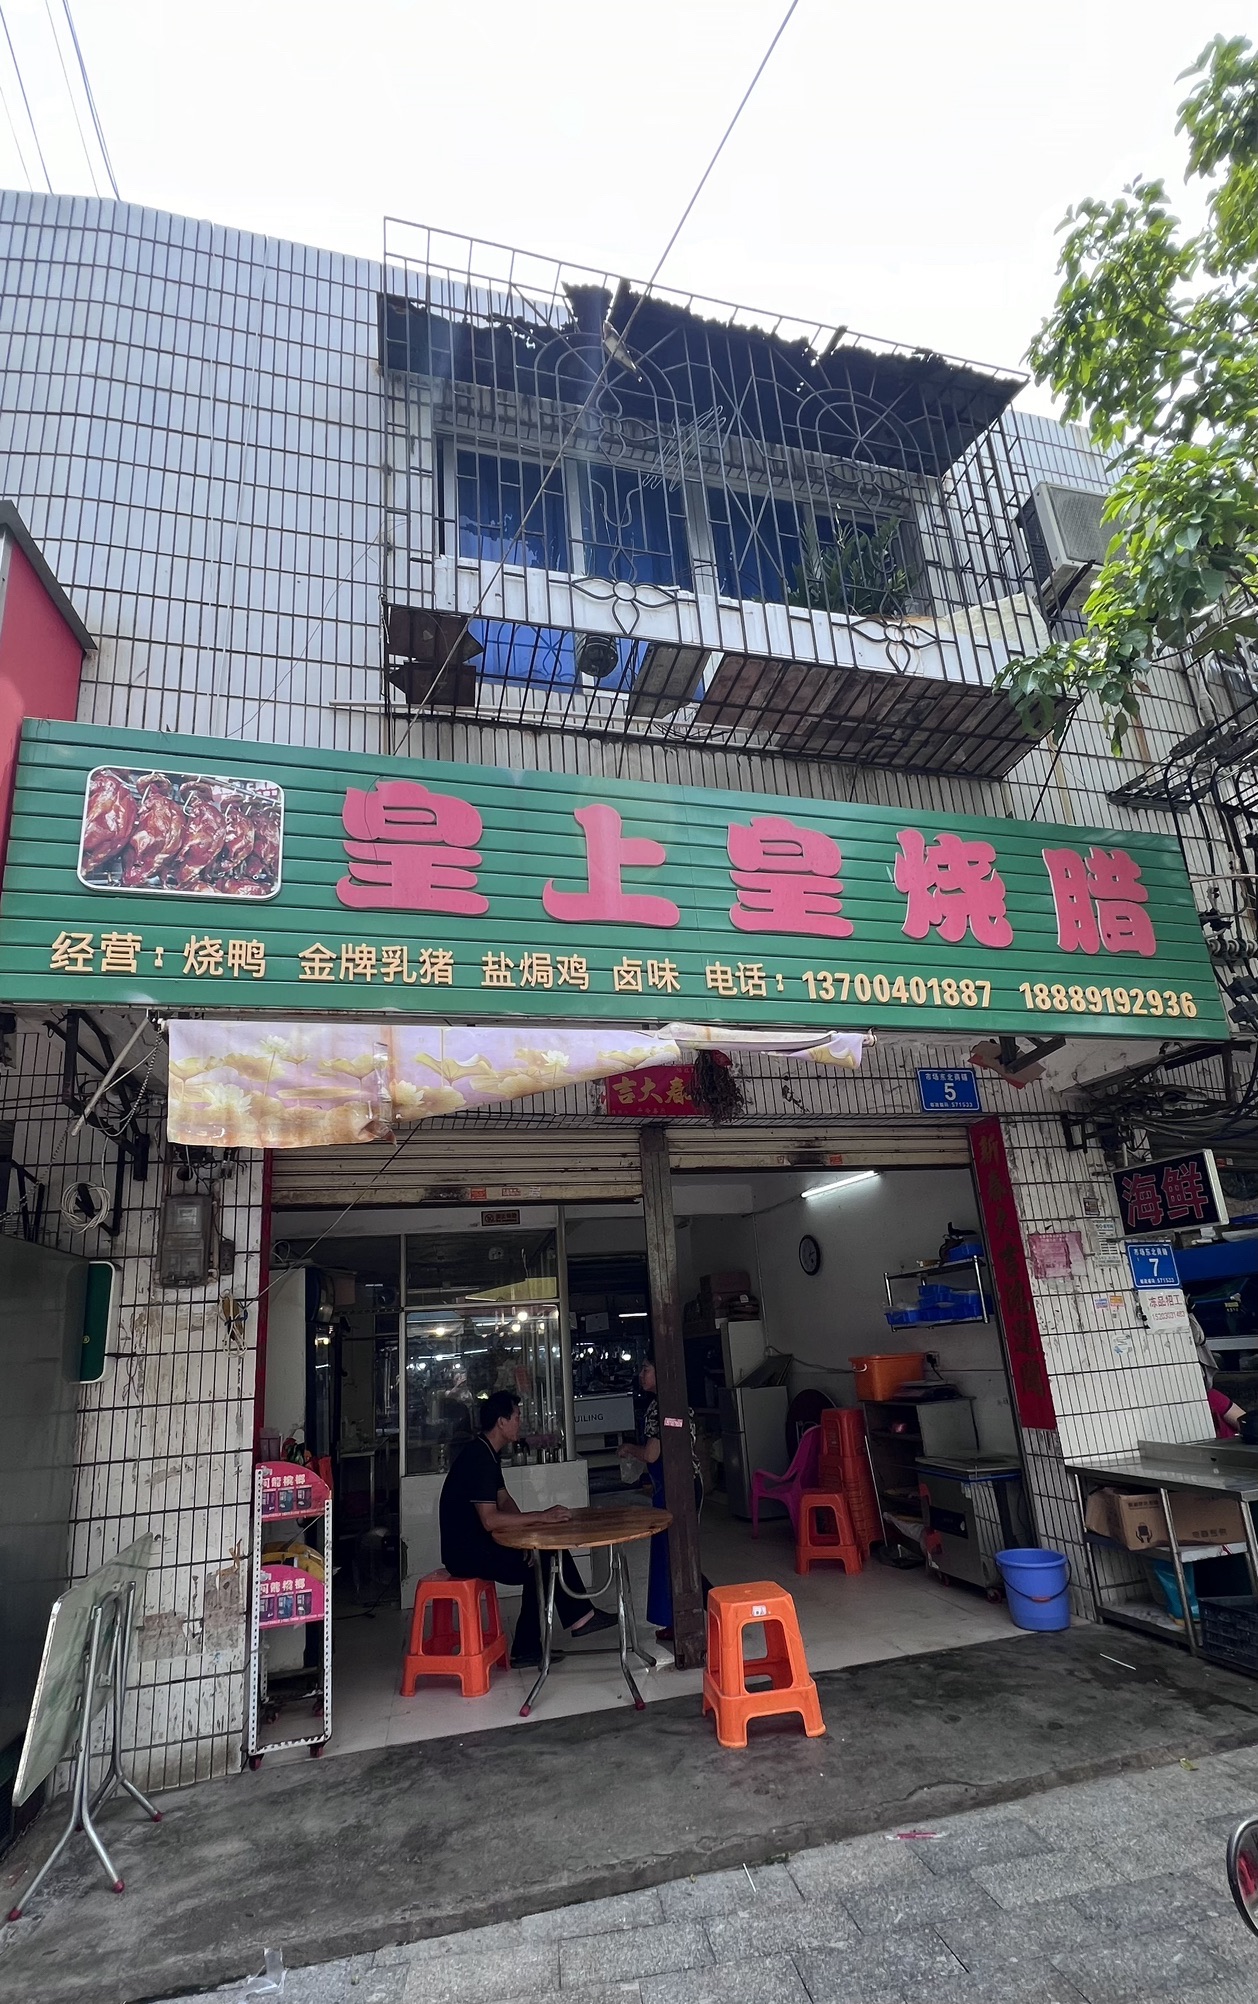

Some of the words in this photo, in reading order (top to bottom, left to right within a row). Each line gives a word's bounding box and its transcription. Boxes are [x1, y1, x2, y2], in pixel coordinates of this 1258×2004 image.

[336, 780, 1157, 957] 皇上皇烧腊
[298, 942, 454, 985] 金牌乳猪
[481, 951, 589, 990] 盐焗鸡
[613, 956, 681, 994] 卤味
[1018, 982, 1198, 1019] 18889192936
[944, 1082, 957, 1101] 5
[1121, 1161, 1209, 1228] 海鲜
[1148, 1258, 1159, 1277] 7
